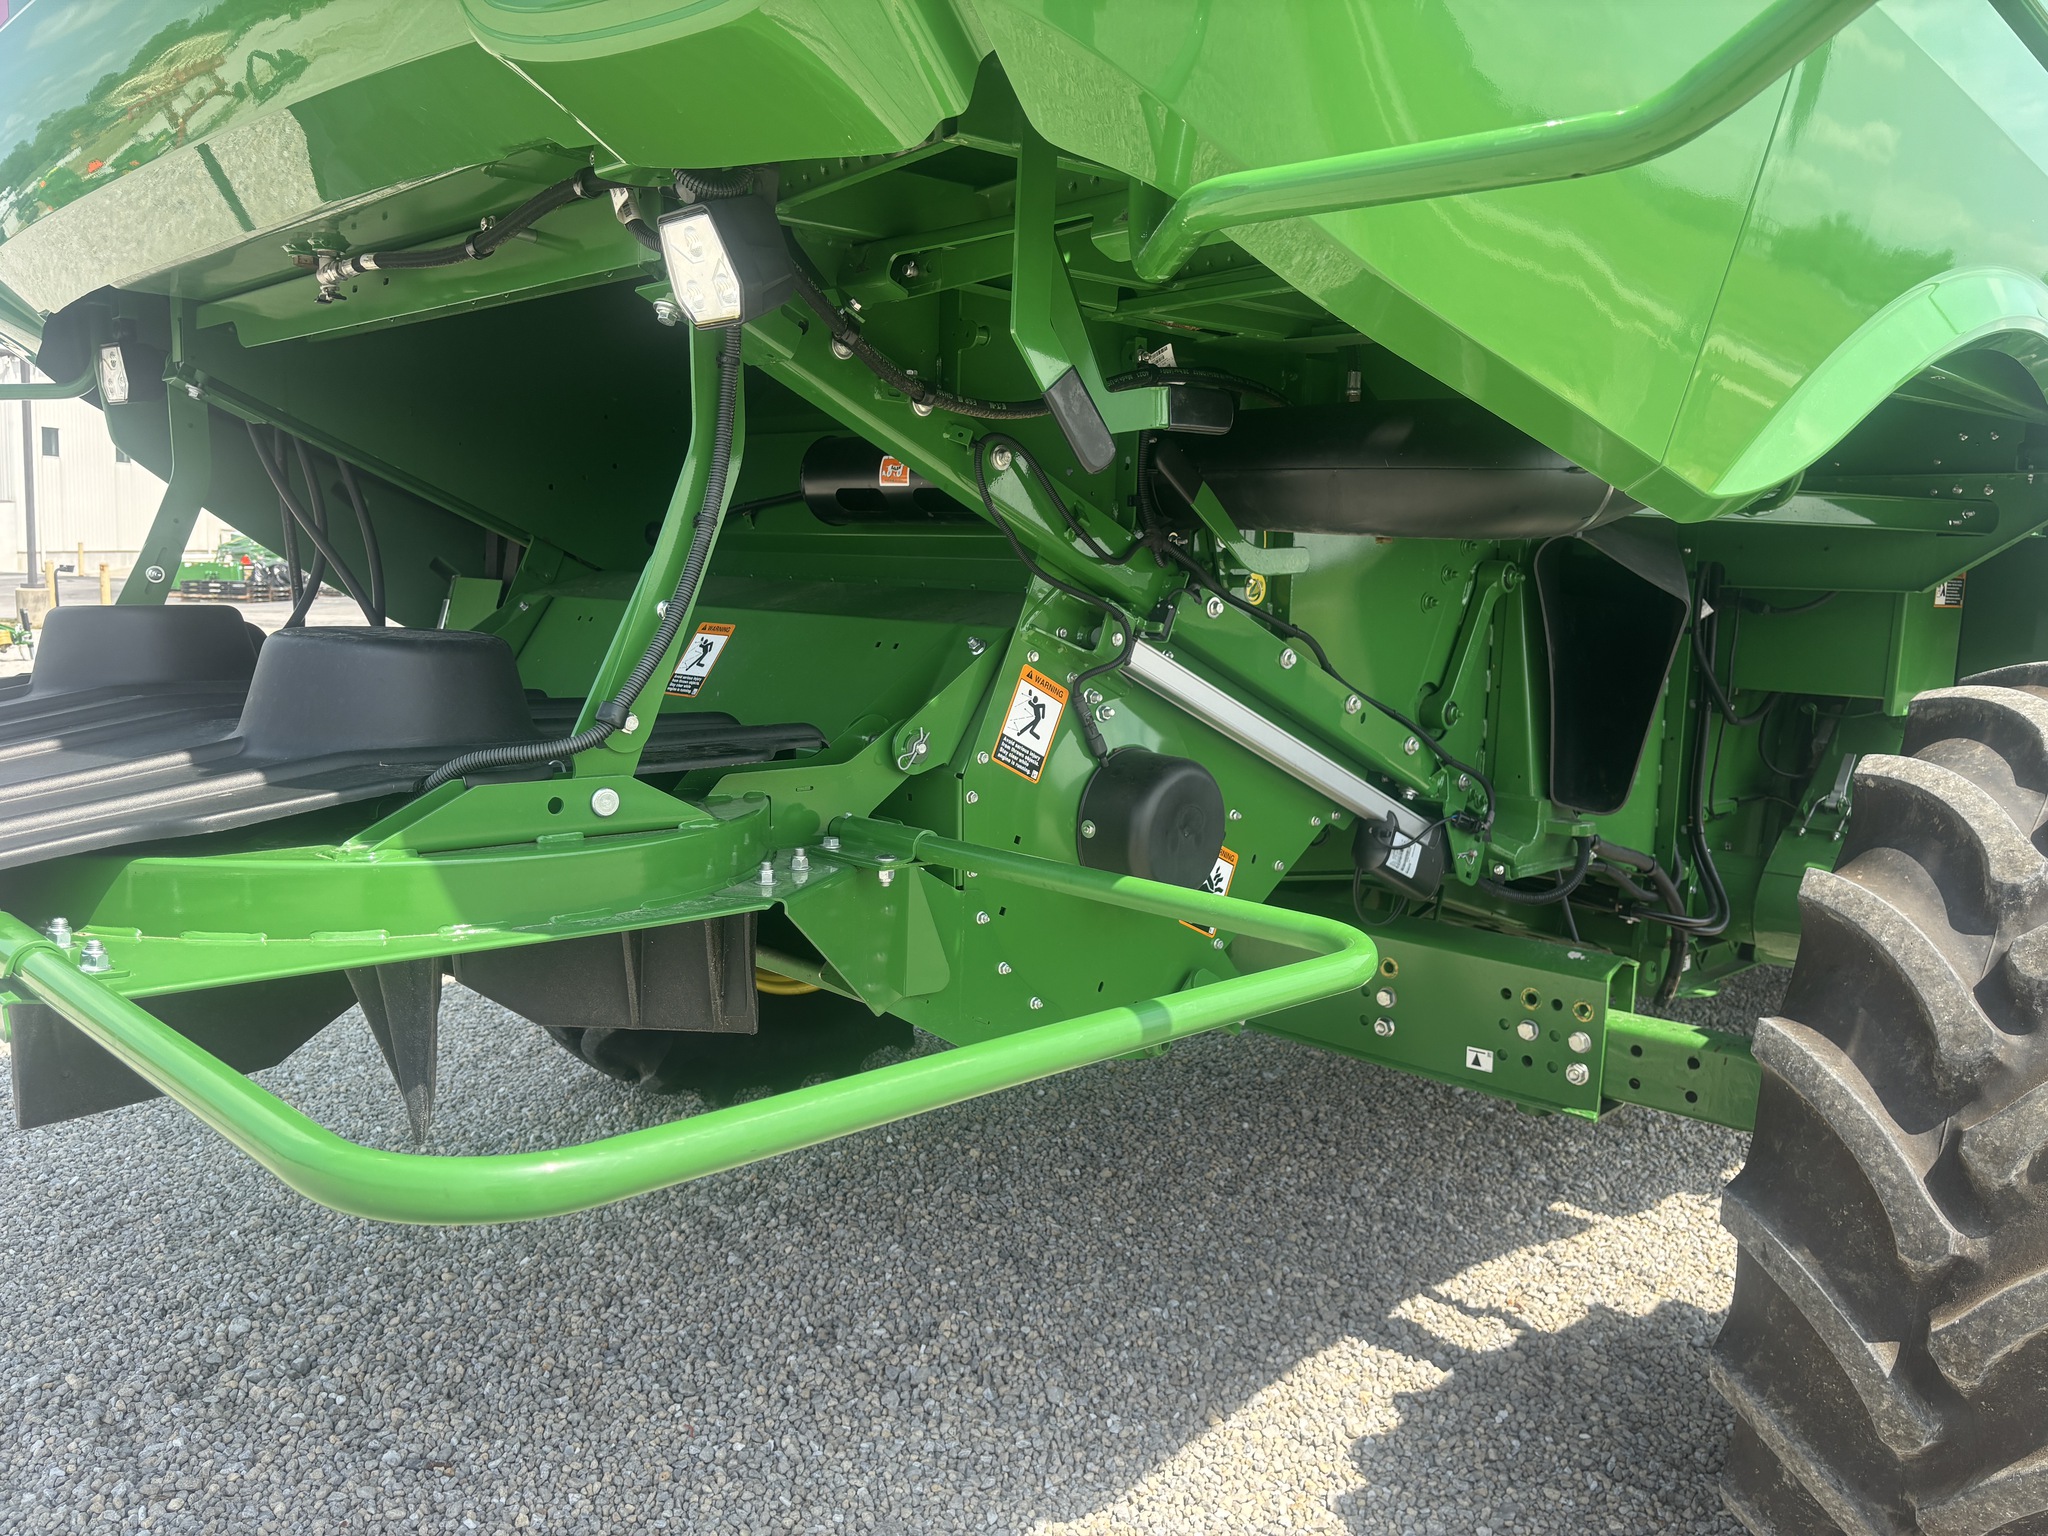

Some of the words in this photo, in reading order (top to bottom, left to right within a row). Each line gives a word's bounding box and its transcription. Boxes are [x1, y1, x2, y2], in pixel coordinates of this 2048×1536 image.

[1035, 675, 1064, 698] WARNING
[1000, 746, 1008, 756] Stay
[1002, 741, 1010, 750] from
[1011, 747, 1024, 758] thrown
[1003, 736, 1015, 746] Avoid
[1015, 744, 1029, 754] serious
[1030, 751, 1040, 761] injury
[998, 753, 1011, 763] engine
